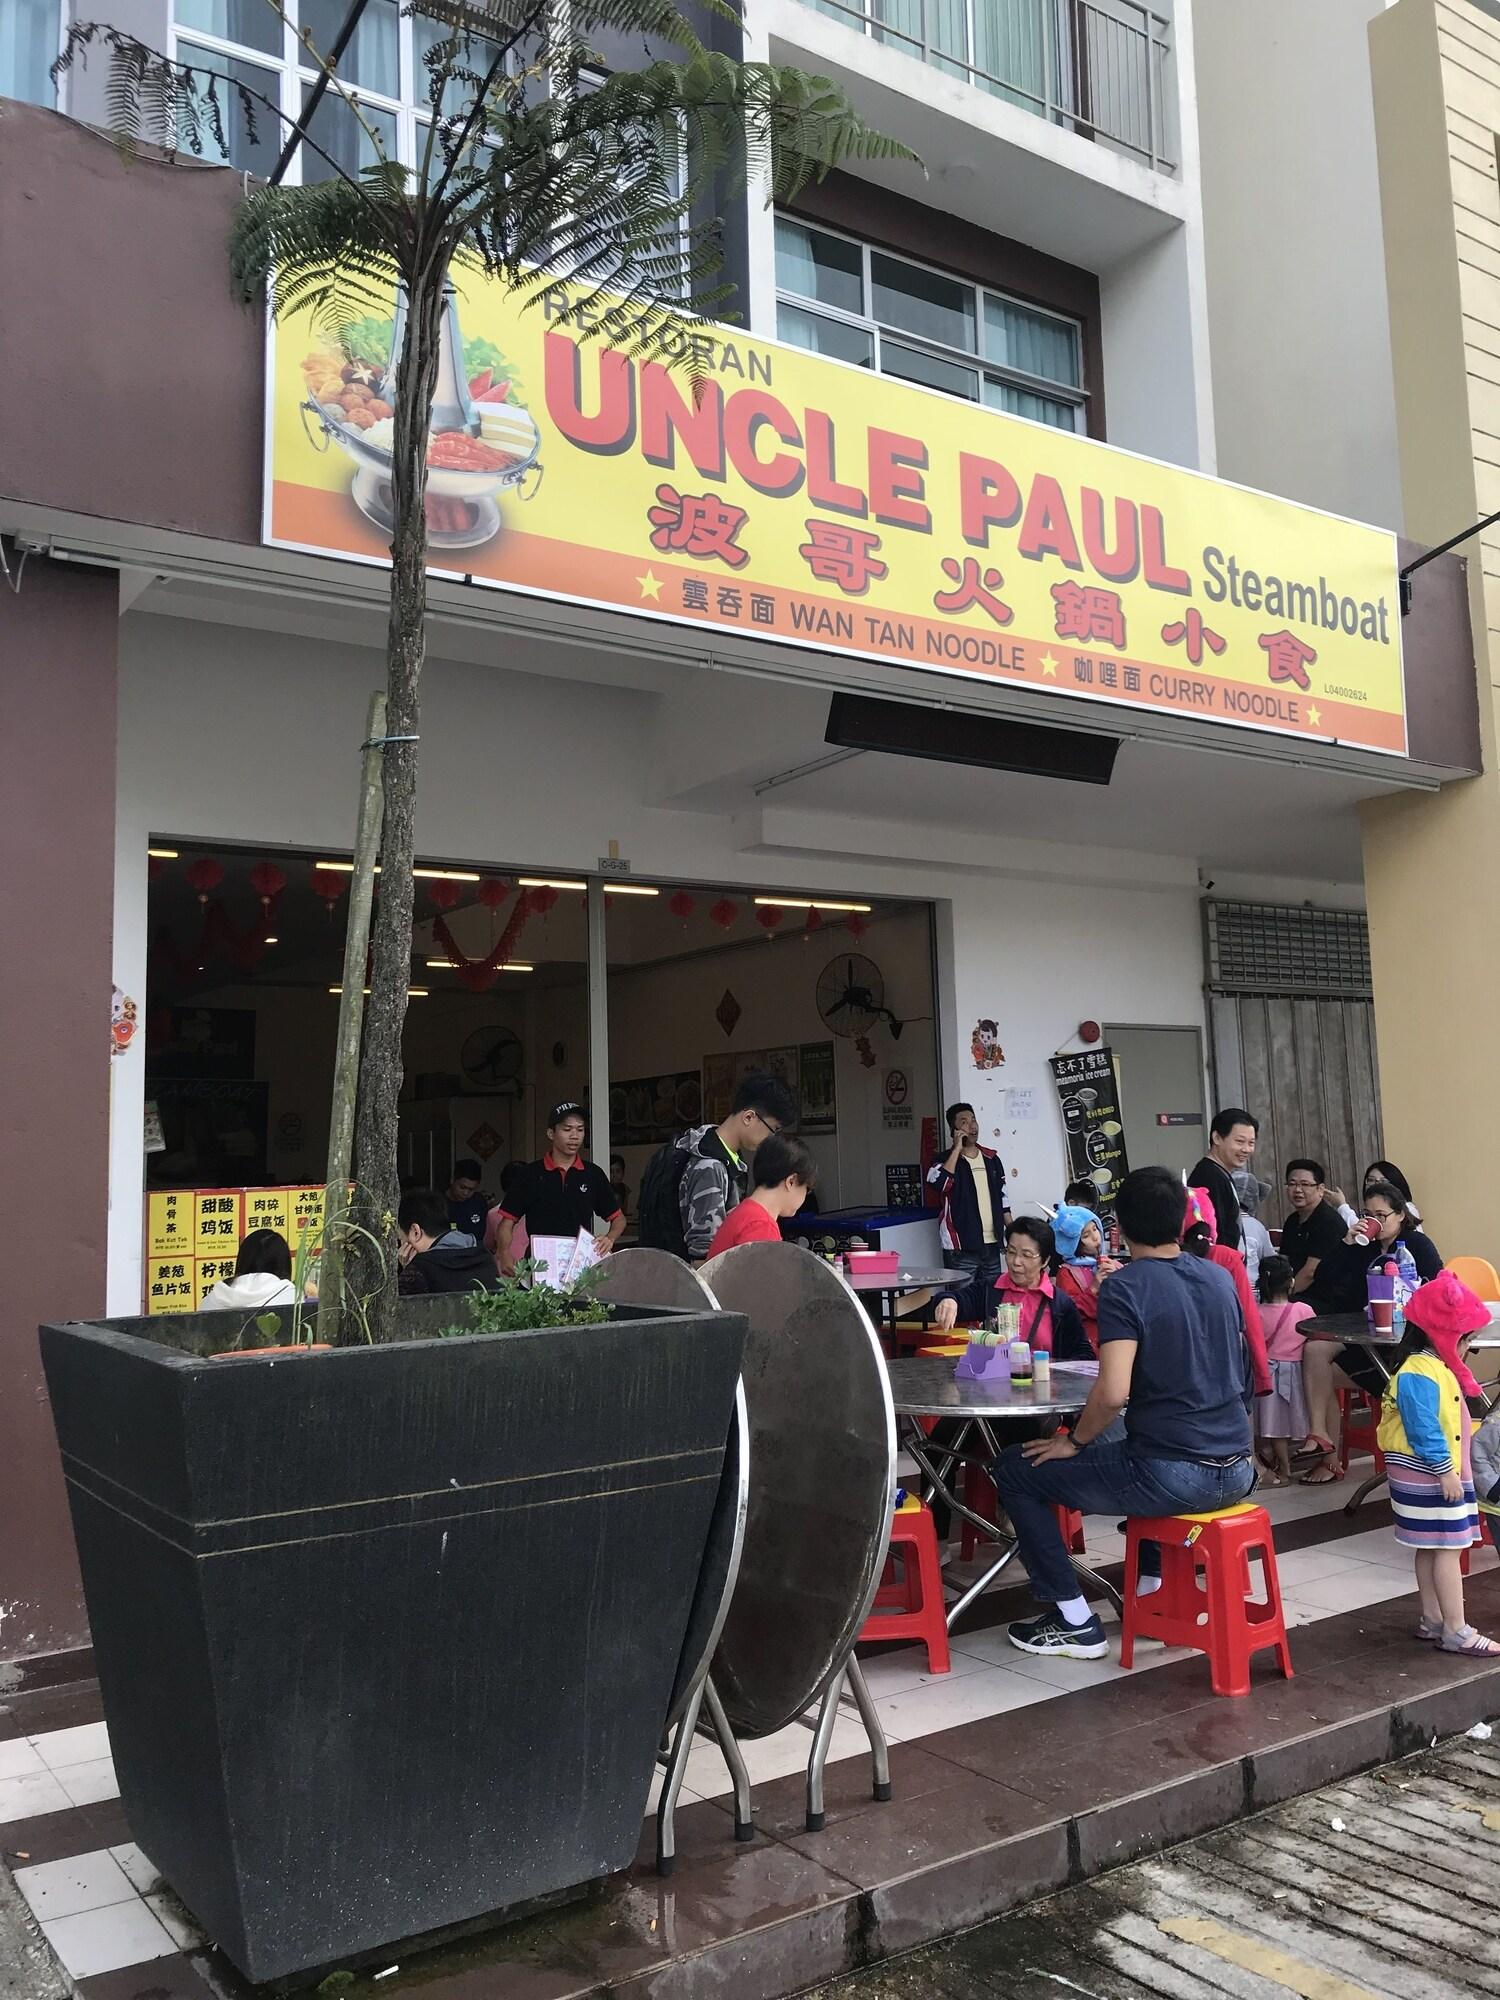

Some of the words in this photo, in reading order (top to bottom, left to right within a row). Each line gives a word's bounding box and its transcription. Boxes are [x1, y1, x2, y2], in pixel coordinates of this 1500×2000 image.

[543, 289, 773, 387] RESTORAN
[544, 331, 932, 534] UNCLE
[959, 451, 1191, 596] PAUL
[1202, 546, 1390, 645] Steamboat
[682, 577, 775, 626] 雲吞面
[791, 600, 853, 640] WAN
[864, 617, 914, 652] TAN
[926, 629, 1025, 672] NOODLE
[1074, 655, 1141, 692] 咖哩面
[1150, 673, 1216, 705] CURRY
[1223, 686, 1299, 724] NOODLE
[1085, 1070, 1094, 1081] ice
[166, 1195, 177, 1234] 肉骨茶
[201, 1198, 234, 1214] 甜酸
[254, 1199, 279, 1211] 肉碎
[201, 1219, 234, 1235] 鸡饭
[248, 1215, 285, 1228] 豆腐饭
[158, 1265, 185, 1279] 姜葱
[151, 1282, 191, 1296] 鱼片饭
